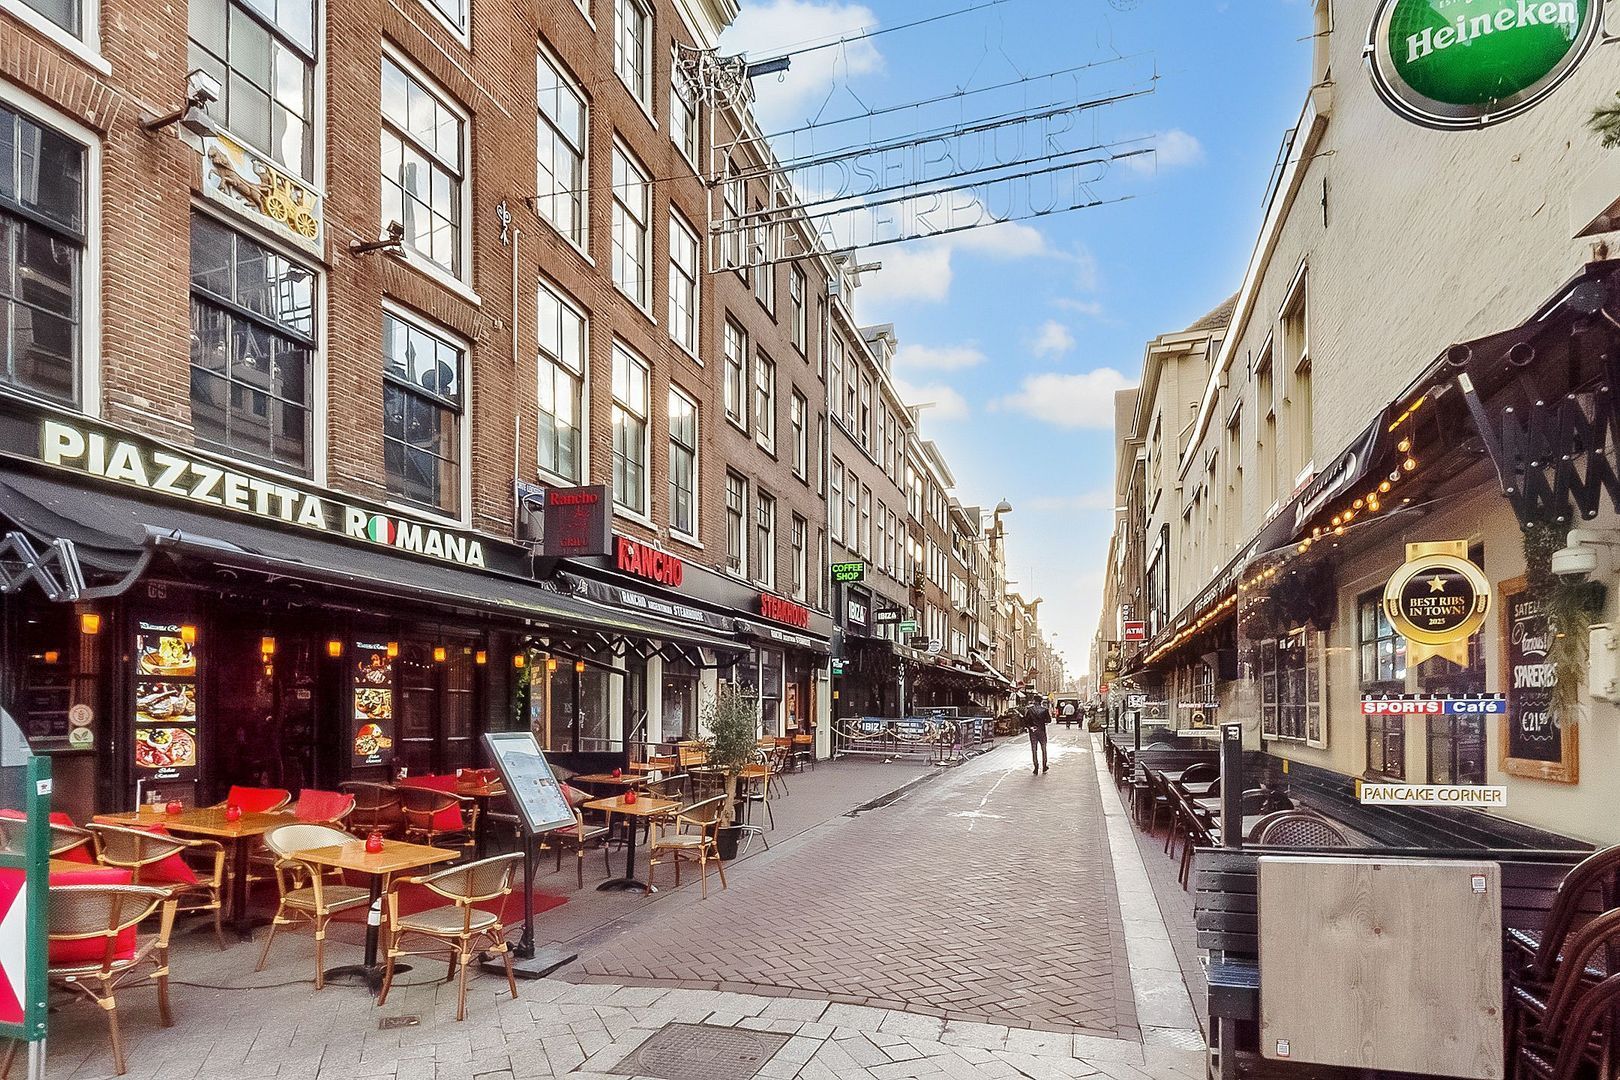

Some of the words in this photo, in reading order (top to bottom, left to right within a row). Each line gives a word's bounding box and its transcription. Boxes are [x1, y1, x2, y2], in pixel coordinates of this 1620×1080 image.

[1406, 0, 1577, 63] Heineken
[44, 420, 327, 530] PIAZZETTA
[345, 505, 486, 568] ROMANA
[550, 490, 597, 505] Rancho
[617, 538, 683, 588] RANCHO
[831, 563, 864, 573] COFFEE
[836, 572, 859, 581] SHOP
[621, 590, 646, 608] RANCHO
[673, 605, 705, 622] STEAKHOUSE
[1410, 597, 1437, 607] BEST
[1439, 596, 1465, 606] RIBS
[761, 592, 810, 629] STEAKHOUSE
[848, 600, 867, 623] IBIZA
[878, 611, 897, 620] IBIZA
[1409, 607, 1422, 617] IN
[1424, 605, 1465, 616] TOWN!
[1126, 627, 1143, 635] ATM
[1365, 692, 1501, 701] SATELLITE
[1364, 701, 1439, 713] SPORTS
[1453, 701, 1498, 713] Café
[1364, 787, 1434, 801] PANCAKE
[1437, 788, 1502, 802] CORNER
